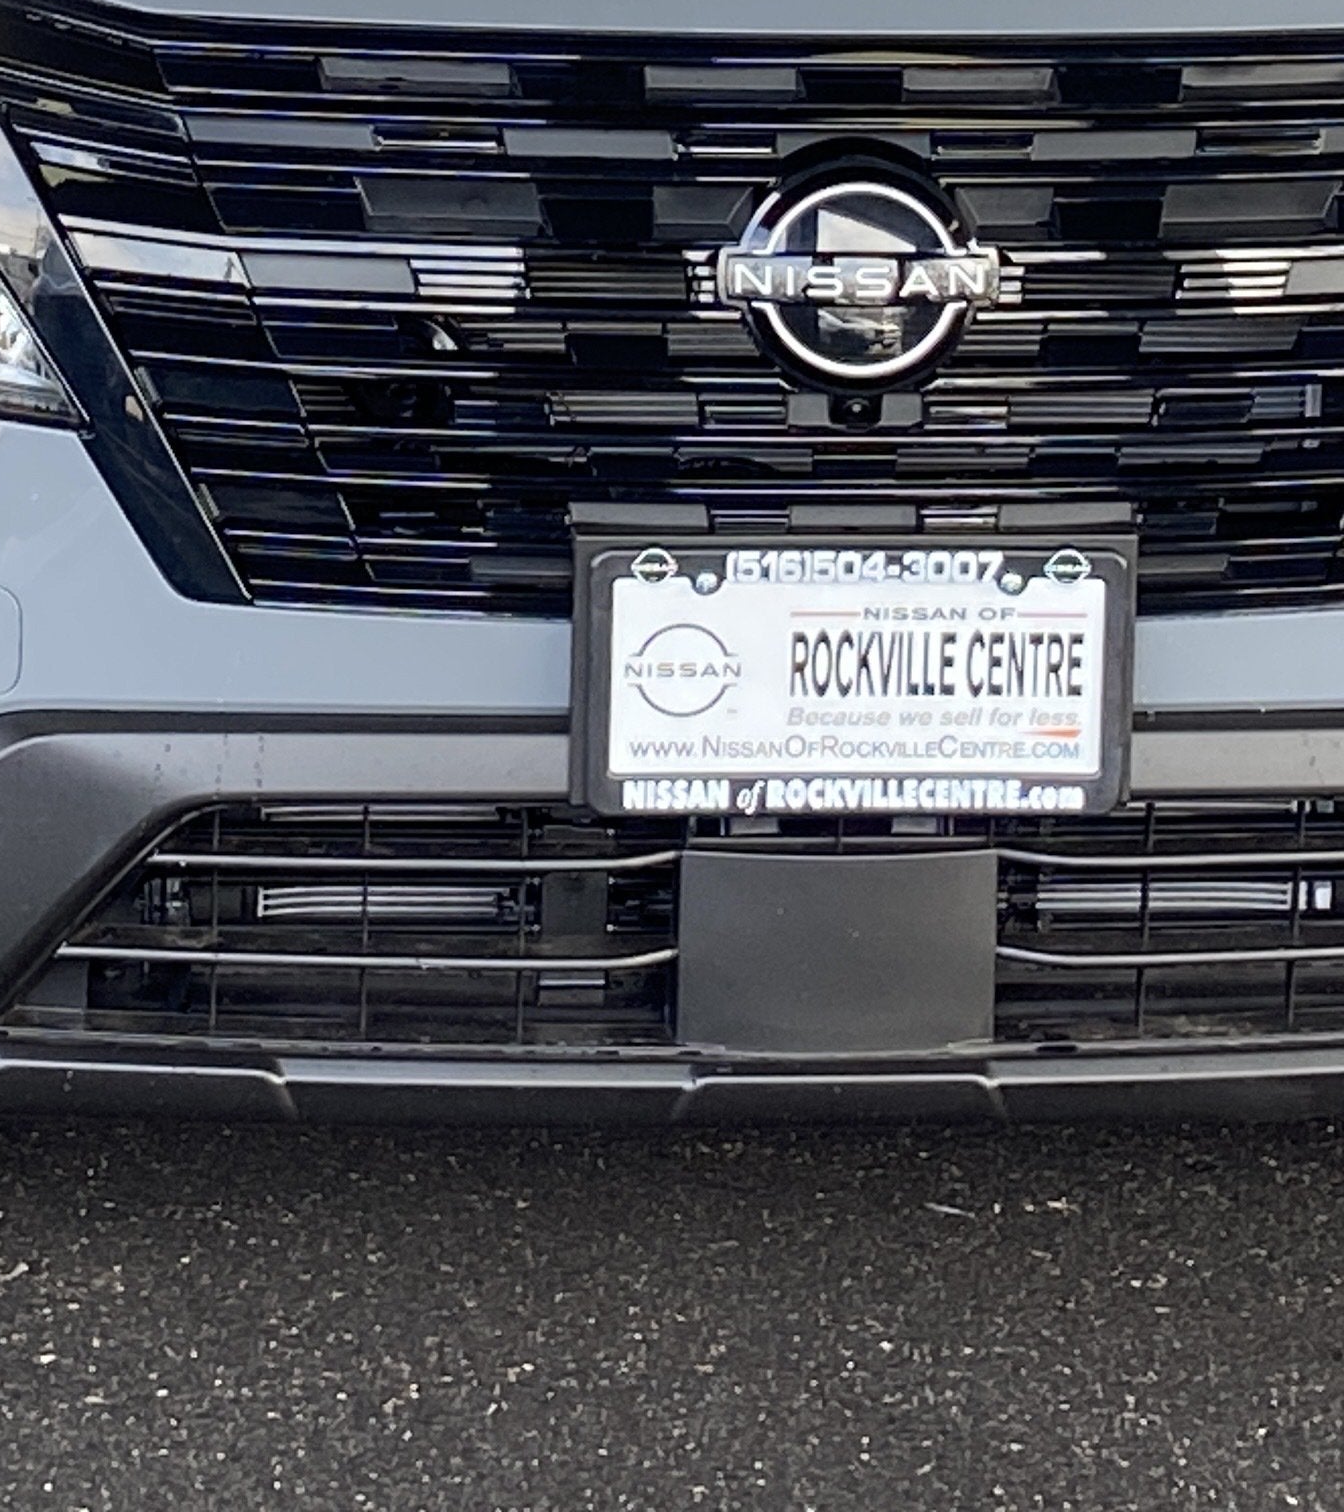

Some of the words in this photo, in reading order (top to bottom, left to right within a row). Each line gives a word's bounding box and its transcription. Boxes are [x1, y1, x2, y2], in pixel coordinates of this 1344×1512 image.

[733, 264, 985, 297] NISSAN
[725, 550, 1004, 584] (516)504-3007
[863, 607, 967, 621] NISSAN
[978, 607, 1016, 621] OF
[624, 662, 742, 679] NISSAN
[789, 628, 956, 698] ROCKVILLE
[966, 628, 1085, 698] CENTRE
[786, 706, 891, 727] Because
[898, 711, 933, 727] we
[939, 706, 983, 727] sell
[988, 706, 1023, 727] for
[1029, 706, 1082, 727] less.
[622, 778, 730, 811] NISSAN
[736, 779, 765, 816] of
[764, 778, 1086, 811] ROCKVILLECENTRE.com
